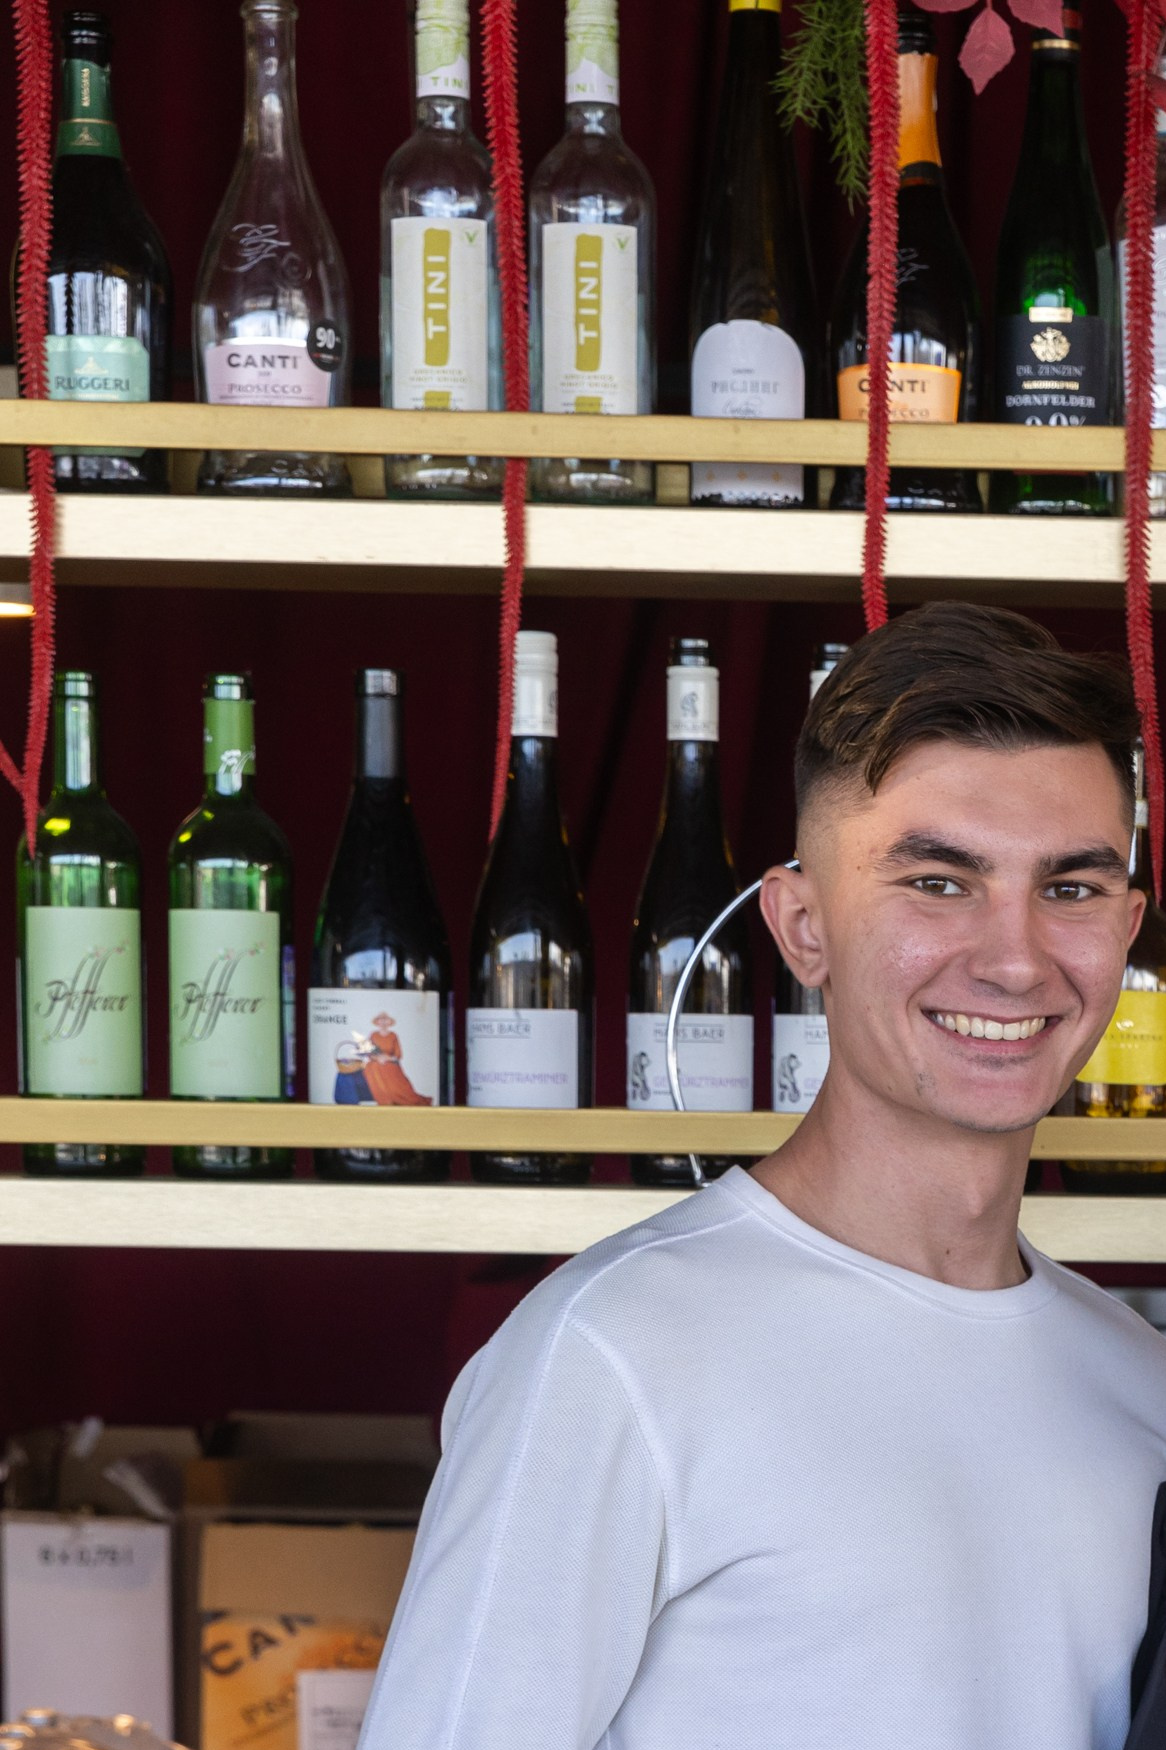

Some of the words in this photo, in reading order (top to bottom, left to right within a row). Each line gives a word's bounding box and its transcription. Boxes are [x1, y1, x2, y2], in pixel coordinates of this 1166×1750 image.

[427, 255, 447, 340] TINI
[578, 261, 598, 346] TINI
[227, 353, 298, 369] CANTI
[55, 375, 130, 392] RUGGERI
[228, 383, 302, 395] PROSECCO
[858, 378, 926, 393] CNTI
[1005, 394, 1096, 408] DORNFELDER
